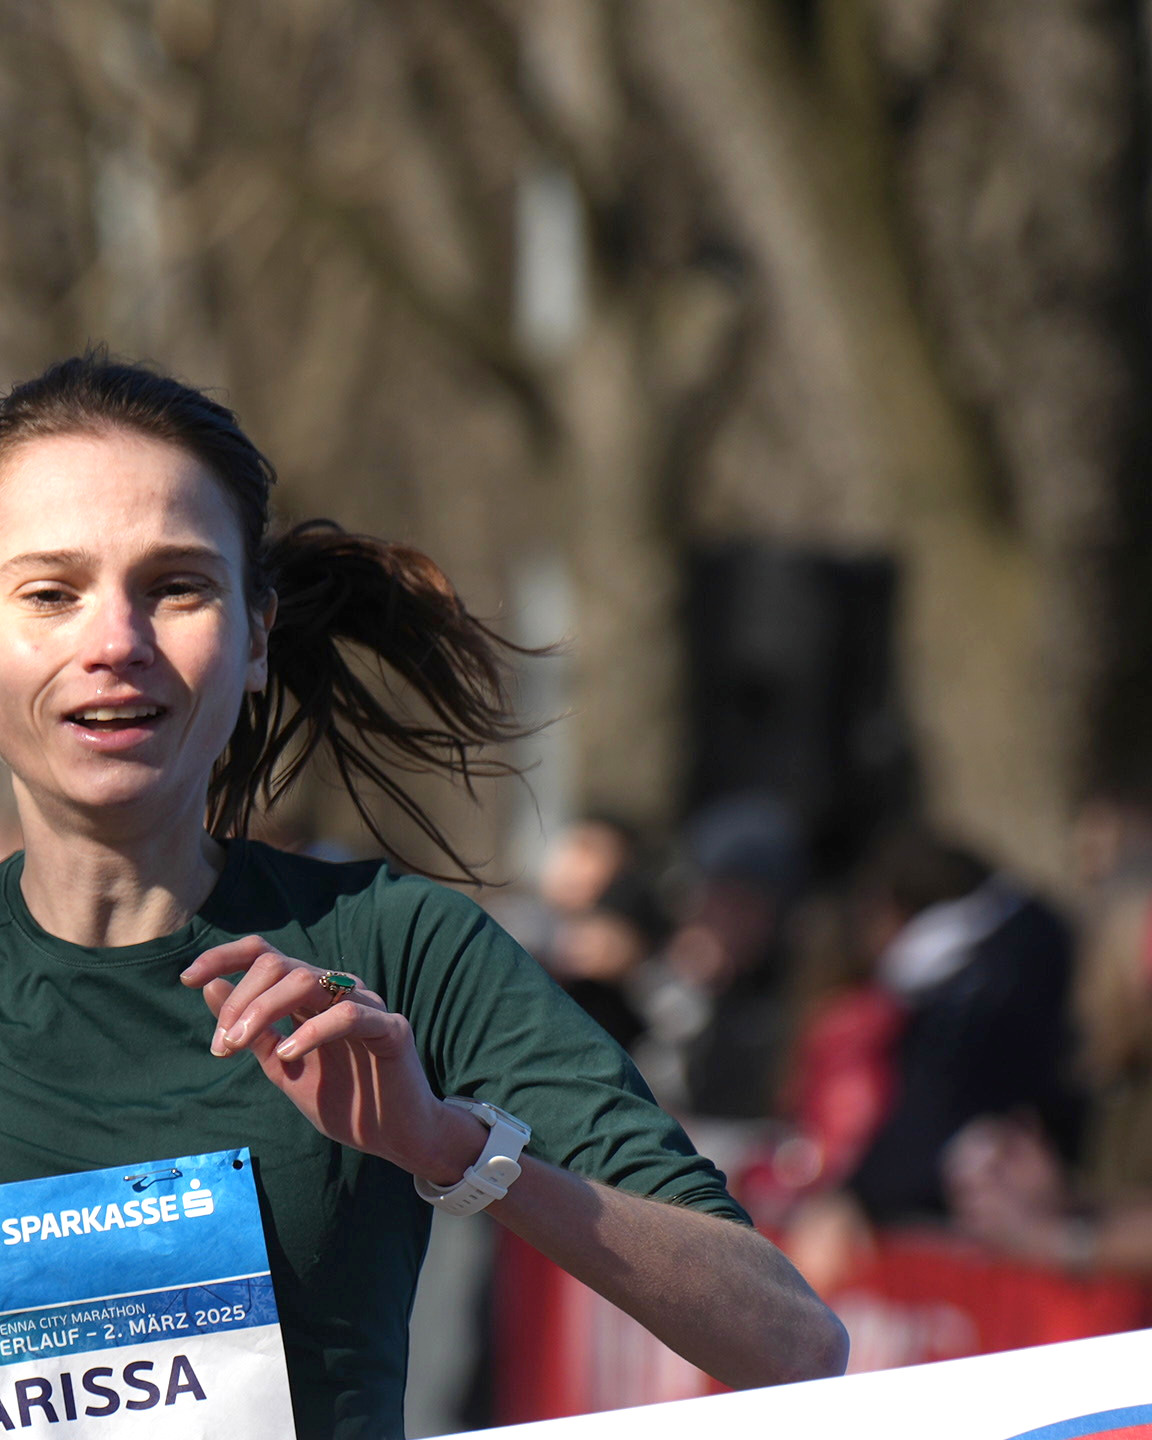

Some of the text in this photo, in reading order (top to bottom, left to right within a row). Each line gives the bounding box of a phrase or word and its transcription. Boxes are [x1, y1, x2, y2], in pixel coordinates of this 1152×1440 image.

[1, 1194, 180, 1246] SPARKASSE
[39, 1314, 68, 1330] CITY
[71, 1303, 146, 1325] MARATHON
[103, 1324, 123, 1341] 2.
[128, 1312, 189, 1337] MÄRZ
[195, 1304, 246, 1327] 2025
